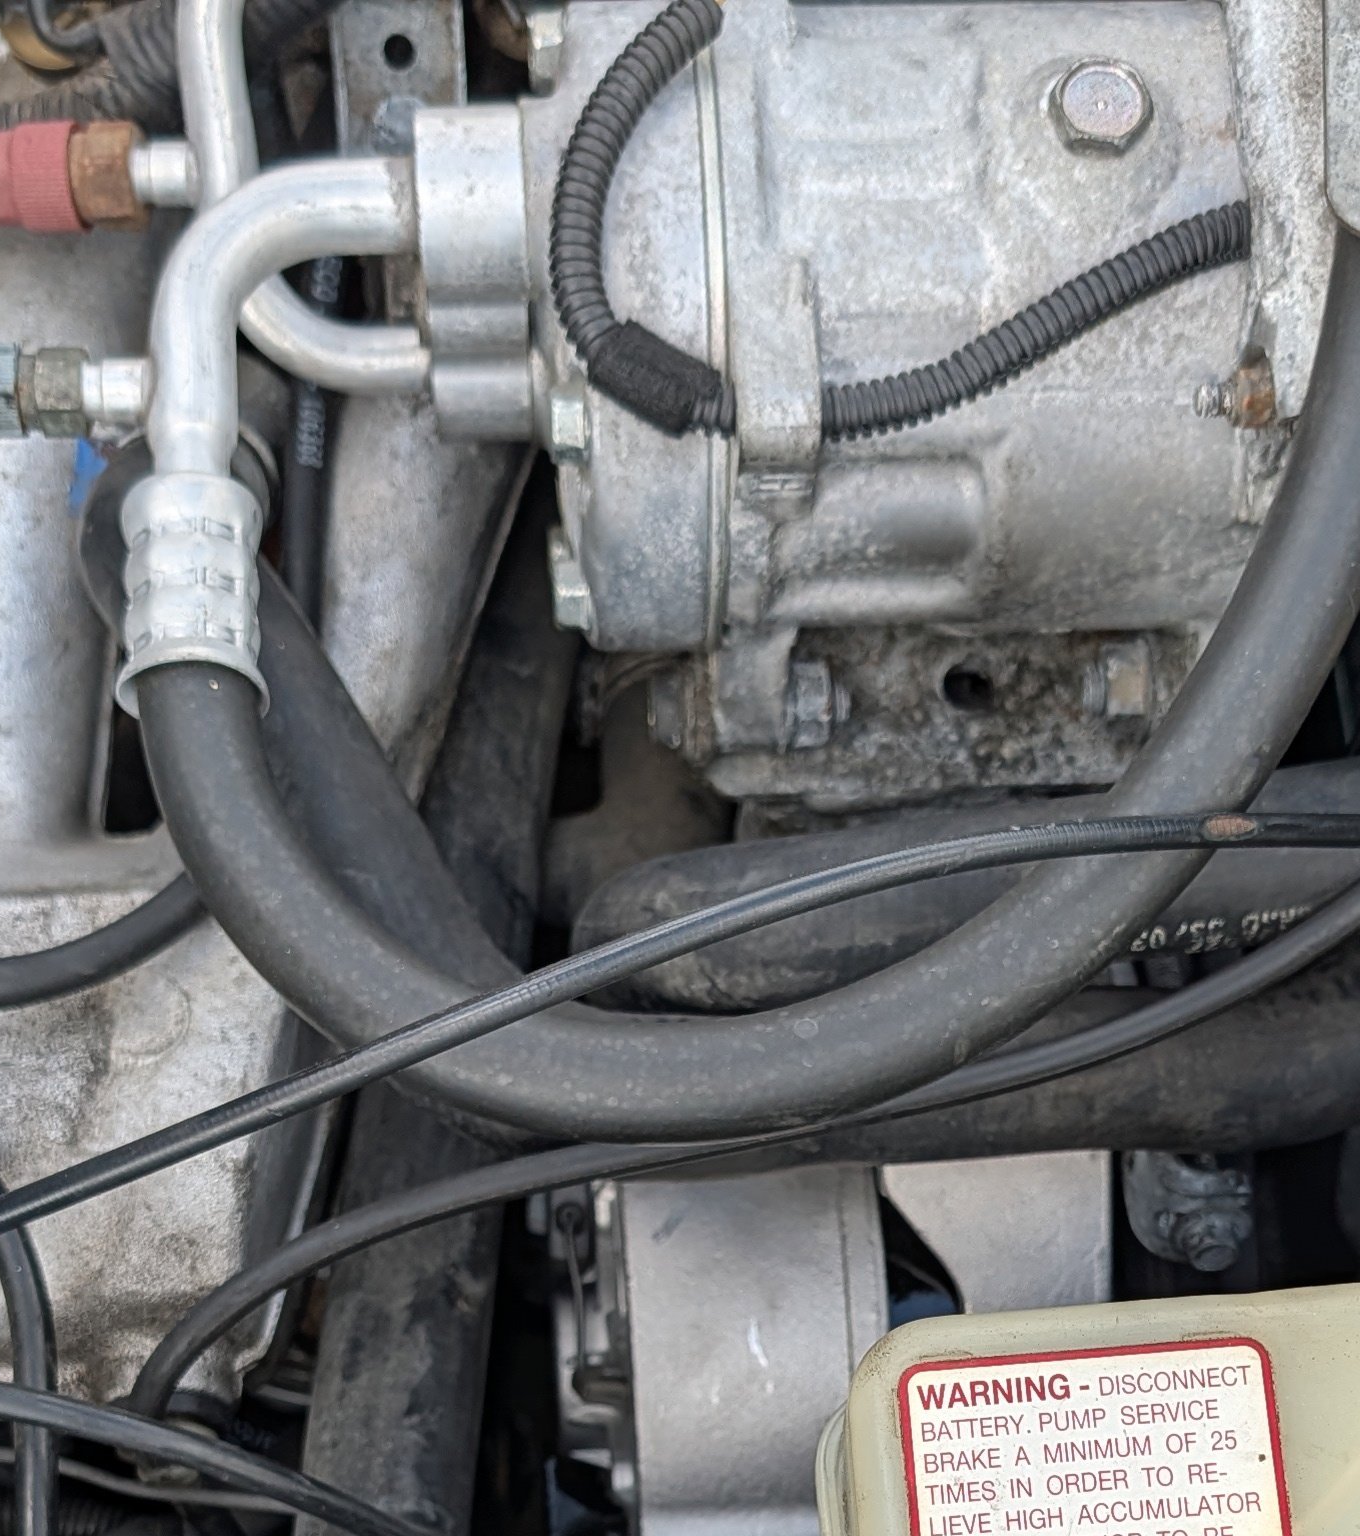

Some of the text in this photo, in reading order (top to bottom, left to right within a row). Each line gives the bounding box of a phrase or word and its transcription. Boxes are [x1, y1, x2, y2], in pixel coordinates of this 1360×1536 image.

[917, 1374, 1071, 1410] WARNING
[1099, 1365, 1251, 1397] DISCONNECT
[921, 1400, 1219, 1442] BATTERY. PUMP SERVICE
[924, 1429, 1237, 1474] BRAKE A MINIMUM OF 25
[925, 1462, 1228, 1505] TIMES IN ORDER TO RE-
[929, 1492, 1261, 1536] LIEVE HIGH ACCUMULATOR
